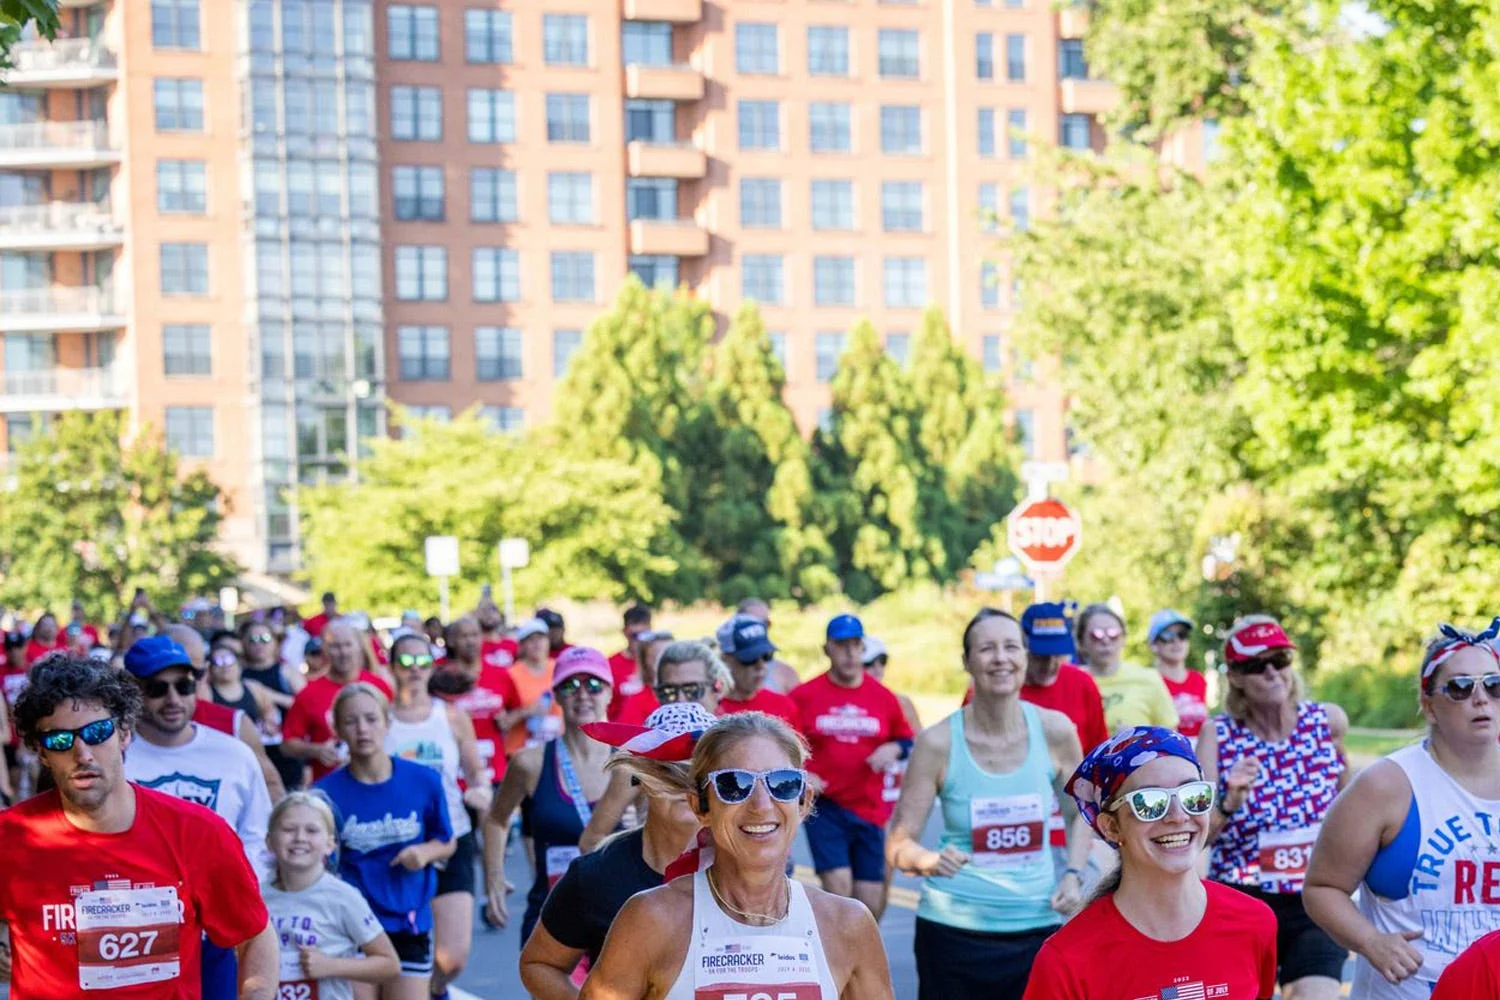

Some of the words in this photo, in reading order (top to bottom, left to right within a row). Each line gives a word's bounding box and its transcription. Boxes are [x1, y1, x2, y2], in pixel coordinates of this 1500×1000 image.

[986, 826, 1031, 849] 856
[1412, 816, 1472, 895] TRUE
[82, 904, 130, 915] FIRECRACKER
[99, 931, 158, 960] 627
[702, 954, 765, 968] FIRECRACKER
[1215, 986, 1228, 995] JULY
